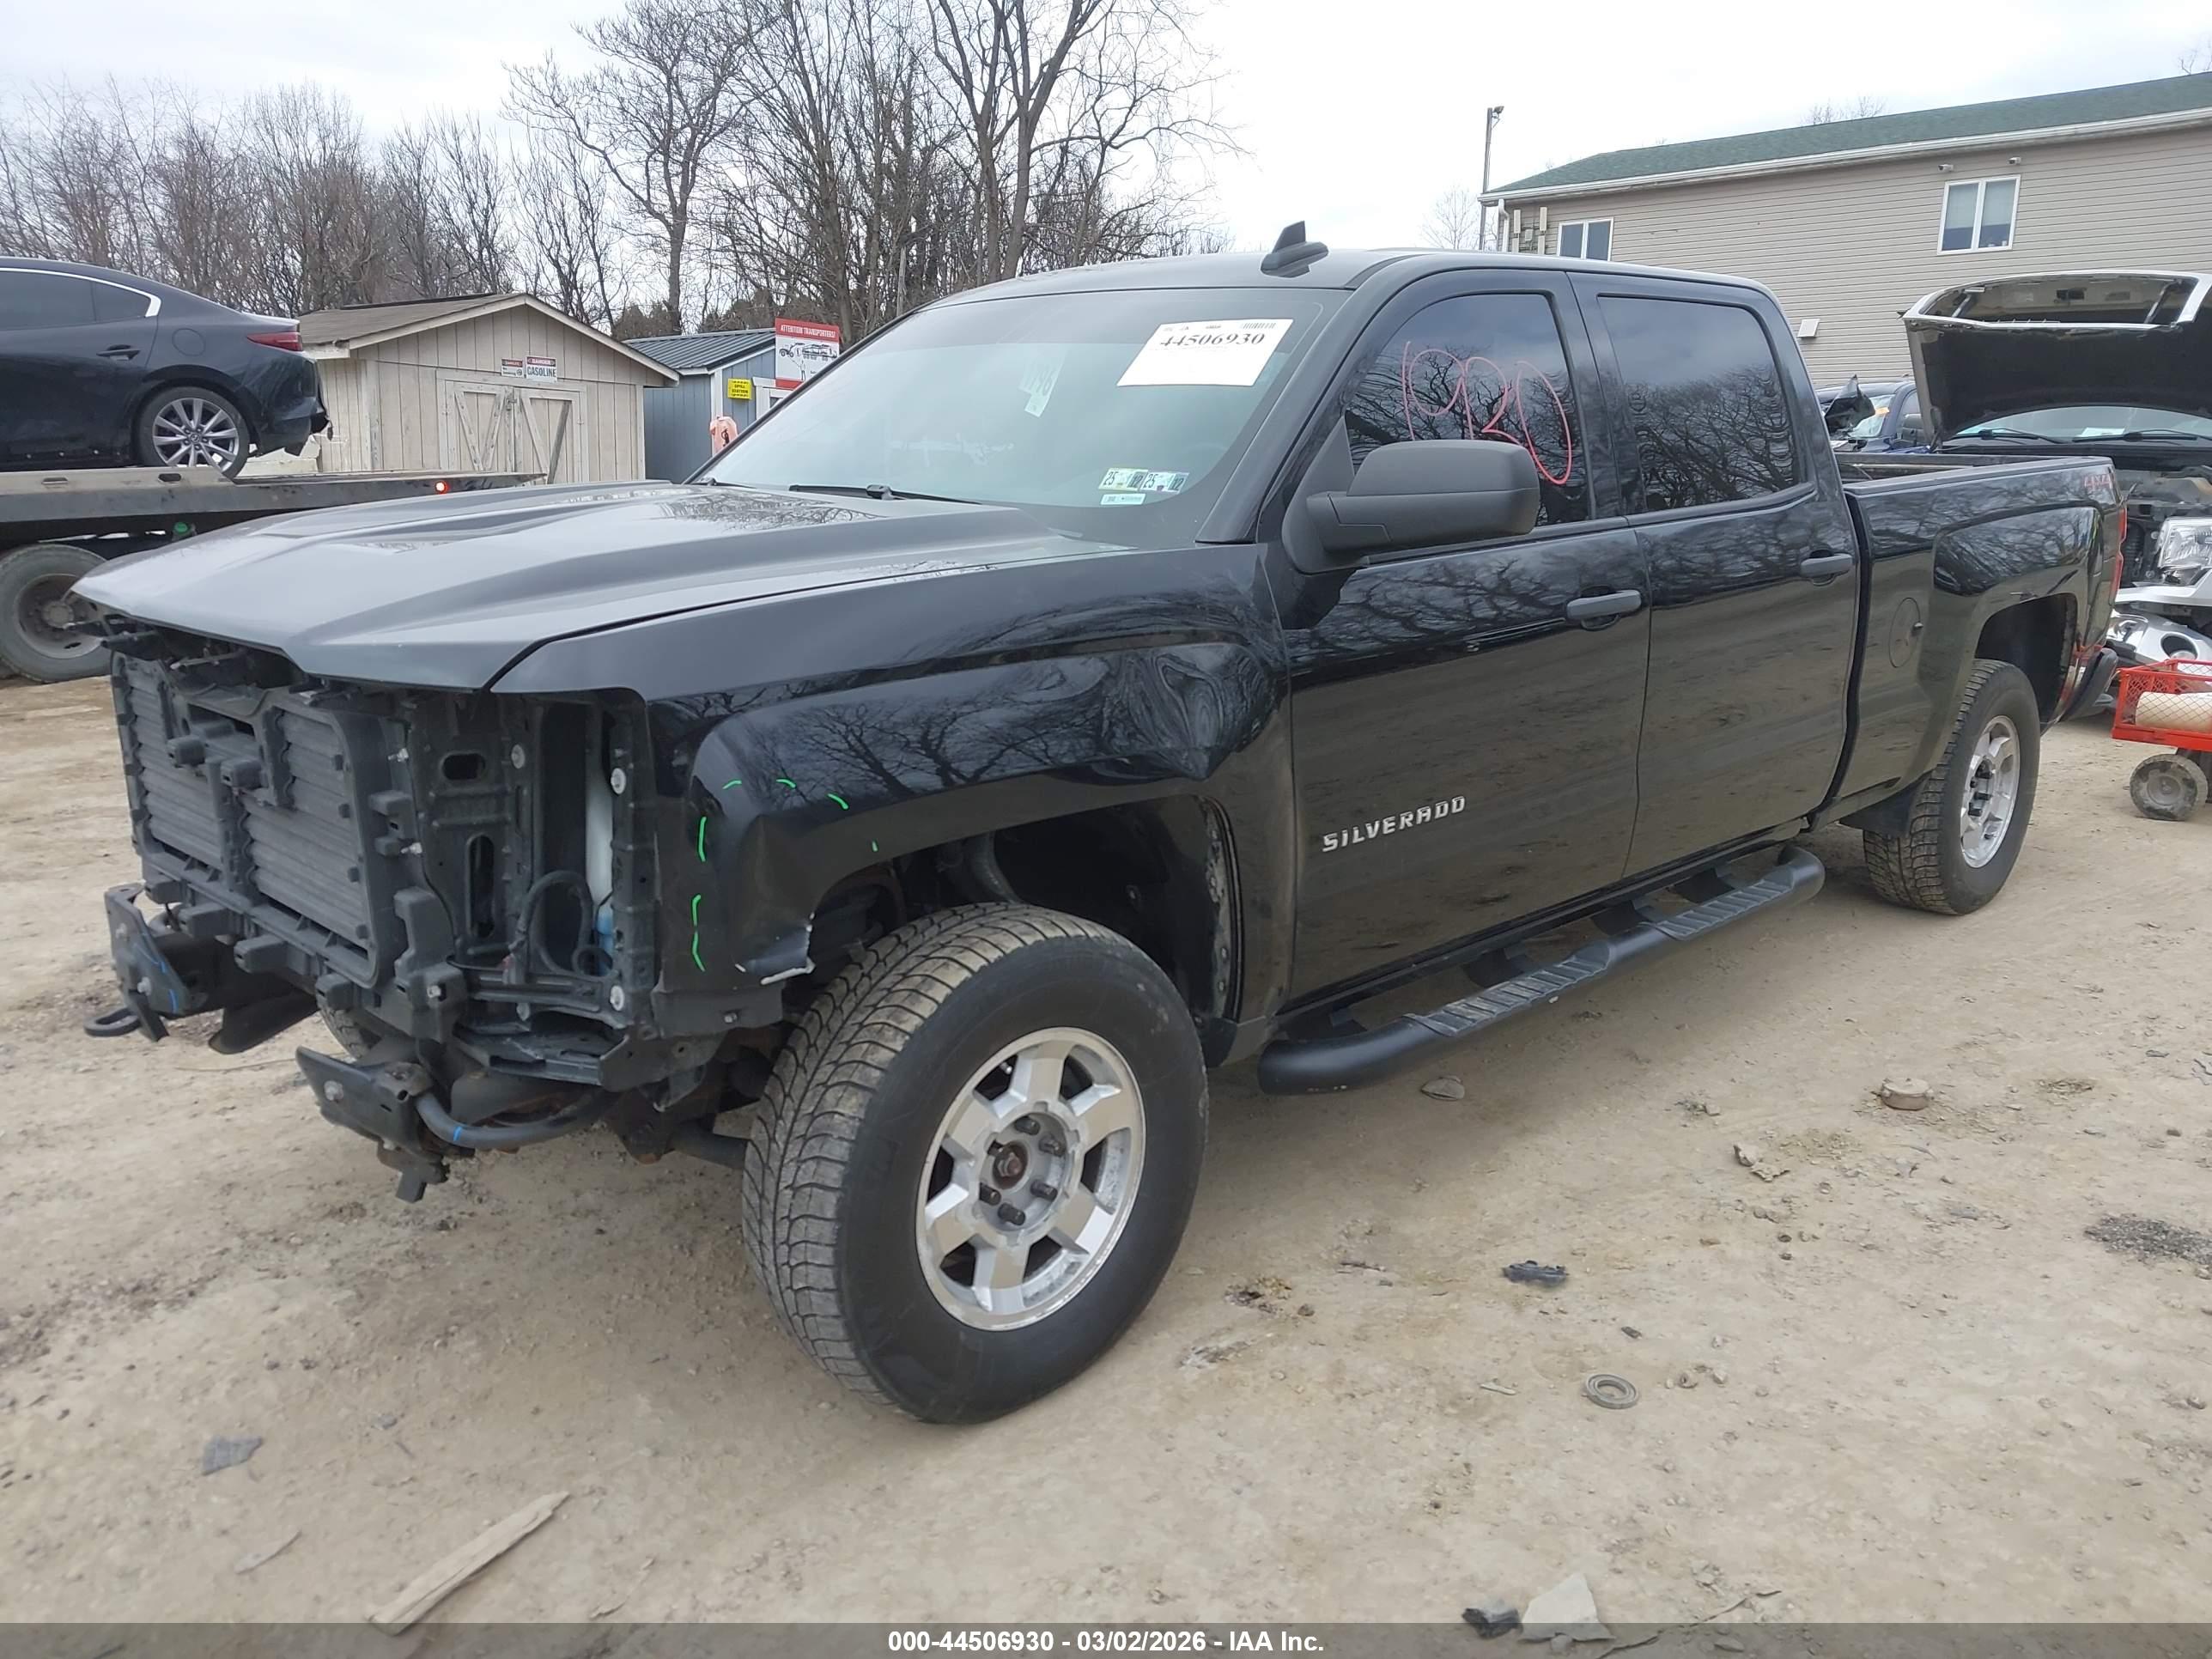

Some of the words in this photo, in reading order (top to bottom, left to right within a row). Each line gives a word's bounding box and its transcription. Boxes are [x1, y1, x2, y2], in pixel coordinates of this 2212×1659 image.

[781, 325, 803, 334] ATTENTION
[1160, 333, 1266, 347] 44506930
[526, 367, 556, 378] GASOLINE
[1103, 471, 1119, 486] 25
[1143, 473, 1158, 489] 25
[1322, 795, 1466, 853] SILVERADO
